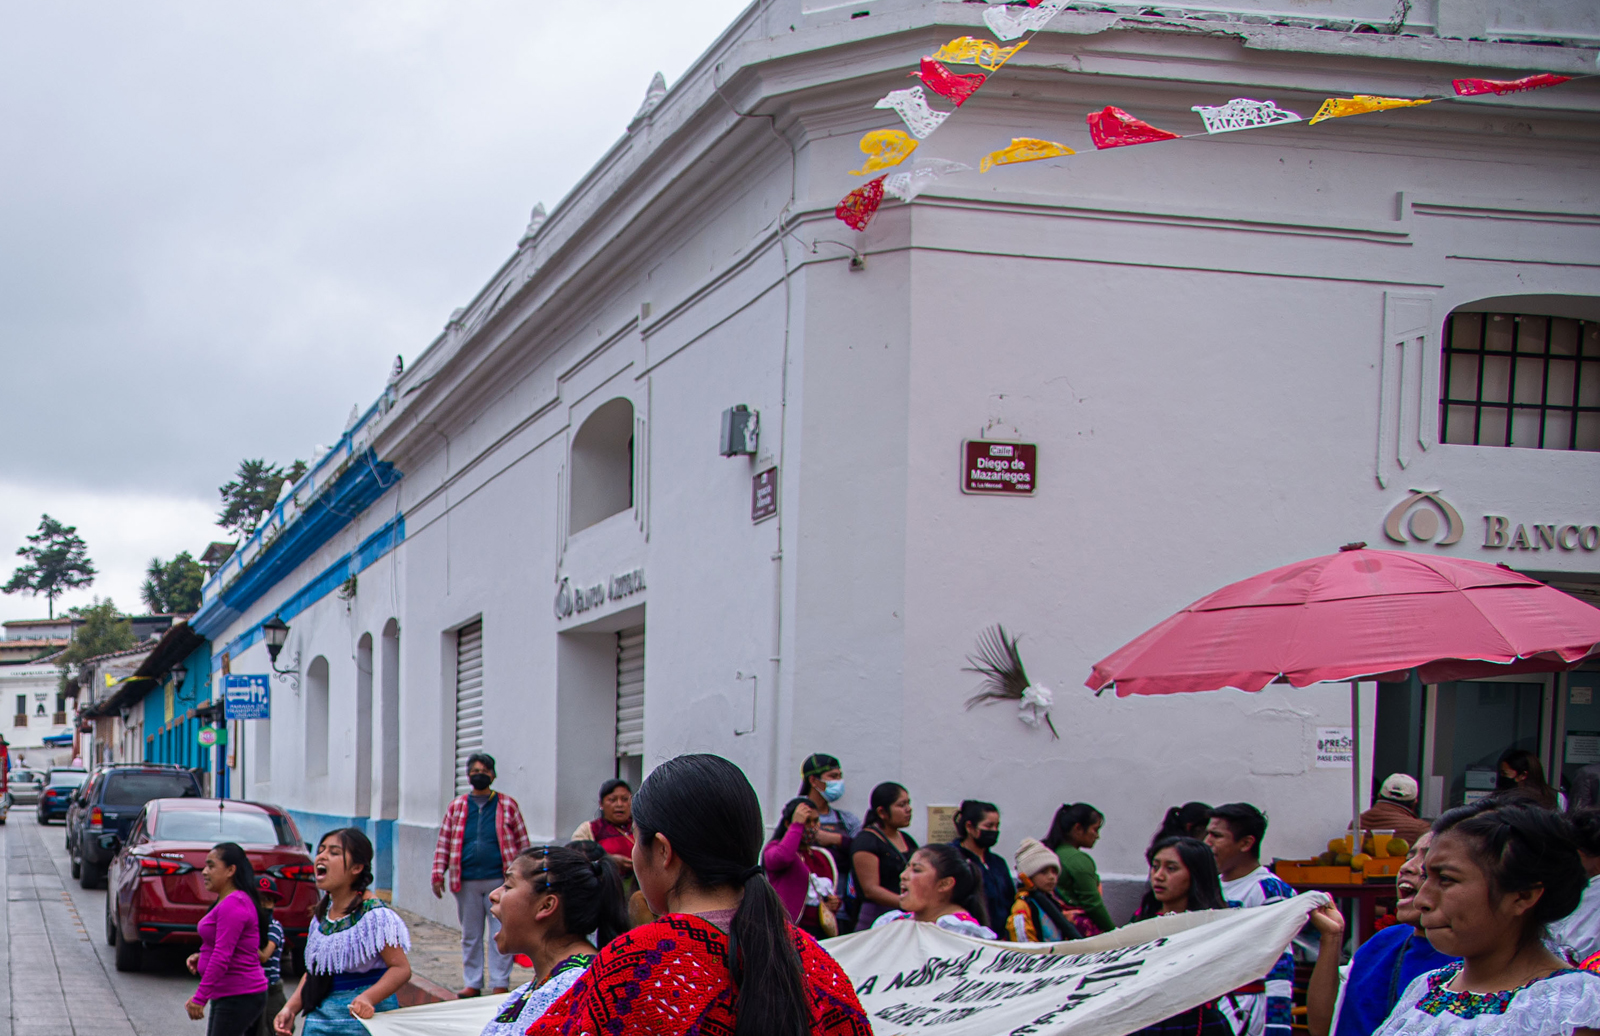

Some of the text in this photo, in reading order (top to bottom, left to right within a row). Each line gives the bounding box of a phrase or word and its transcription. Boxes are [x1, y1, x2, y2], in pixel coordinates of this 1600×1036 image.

[977, 457, 1026, 471] Diego de
[970, 469, 1031, 484] Mazariegos
[1481, 515, 1600, 551] BANCO
